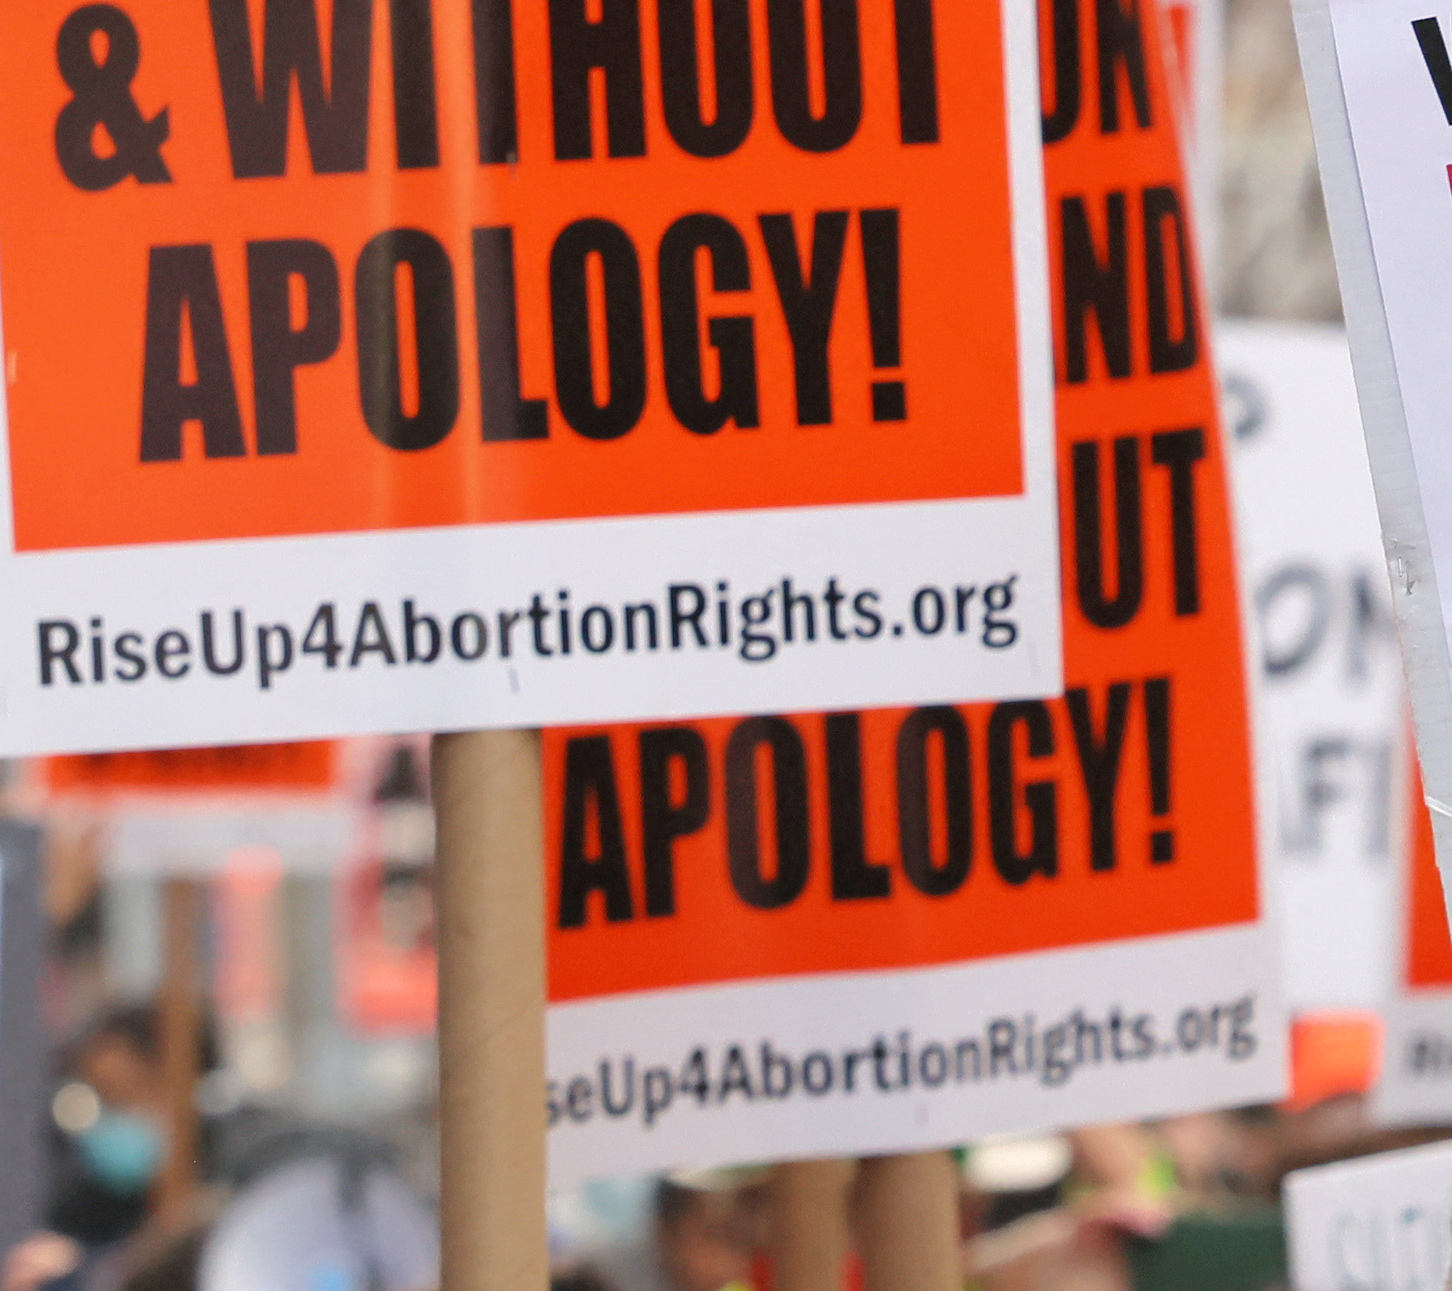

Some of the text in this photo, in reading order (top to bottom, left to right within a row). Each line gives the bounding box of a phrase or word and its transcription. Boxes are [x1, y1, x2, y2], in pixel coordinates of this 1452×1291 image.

[55, 4, 171, 191] &
[209, 0, 939, 179] WITHOUT
[140, 208, 907, 462] APOLOGY!
[1060, 186, 1200, 384] ND
[1072, 428, 1206, 630] UT
[38, 576, 1019, 689] RiseUp4AbortionRights.org
[558, 677, 1174, 930] APOLOGY!
